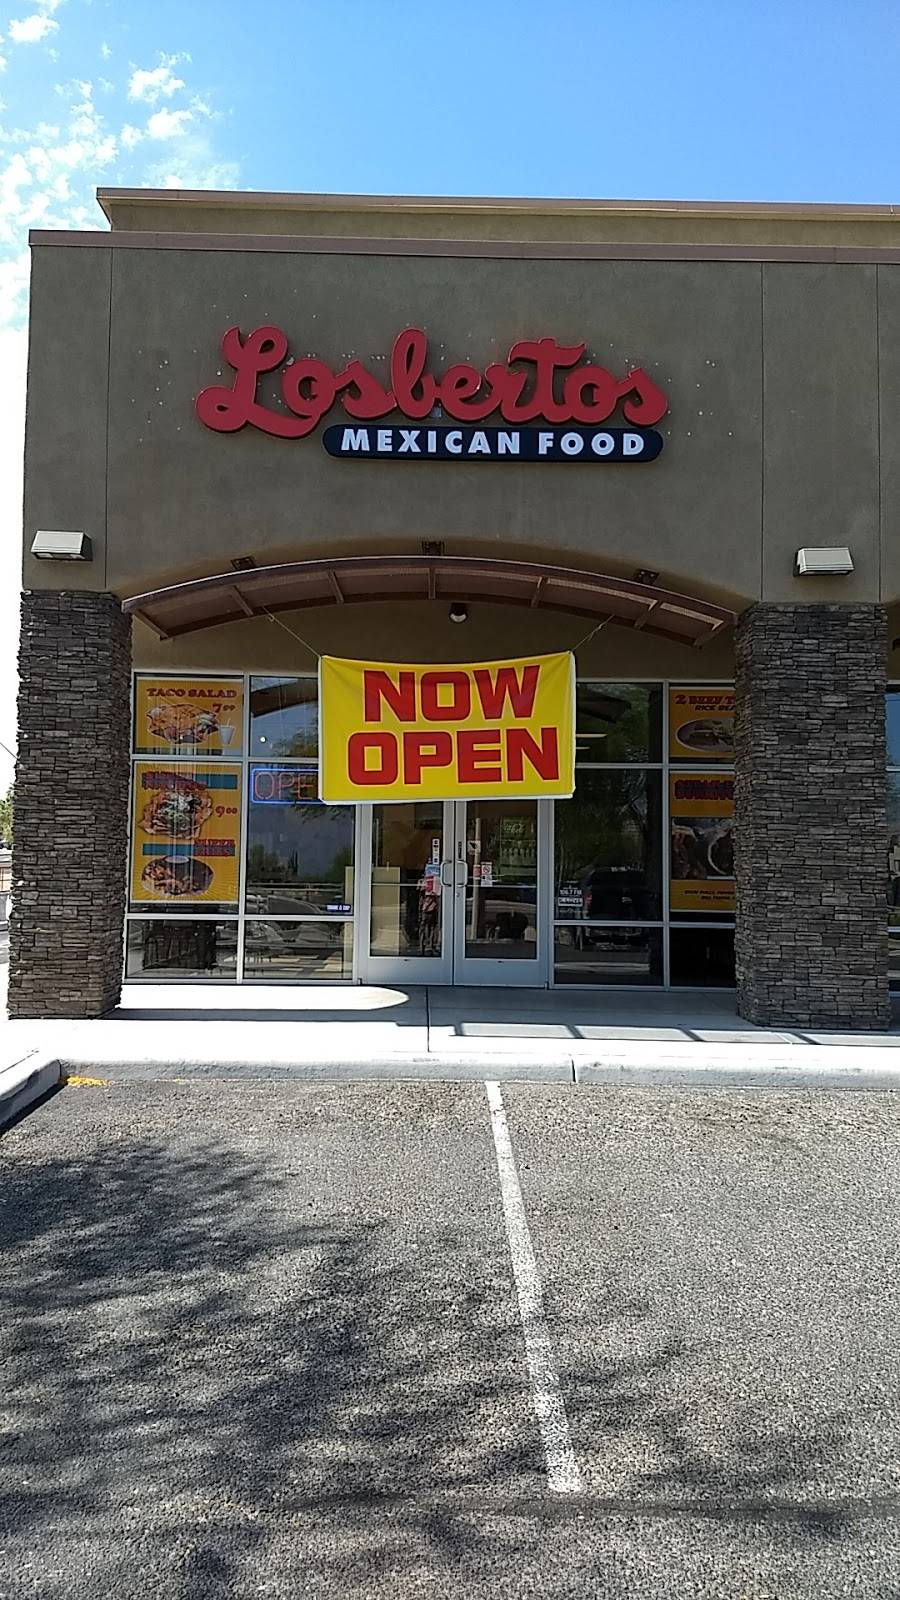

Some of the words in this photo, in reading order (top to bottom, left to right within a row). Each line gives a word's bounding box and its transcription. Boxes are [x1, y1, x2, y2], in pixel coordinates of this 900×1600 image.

[341, 428, 521, 455] MEXICAN
[538, 431, 645, 456] FOOD
[146, 687, 186, 697] TACO
[188, 689, 237, 698] SALAD
[363, 664, 541, 723] NOW
[675, 694, 687, 705] 2
[347, 727, 560, 786] OPEN
[255, 771, 317, 800] OPE
